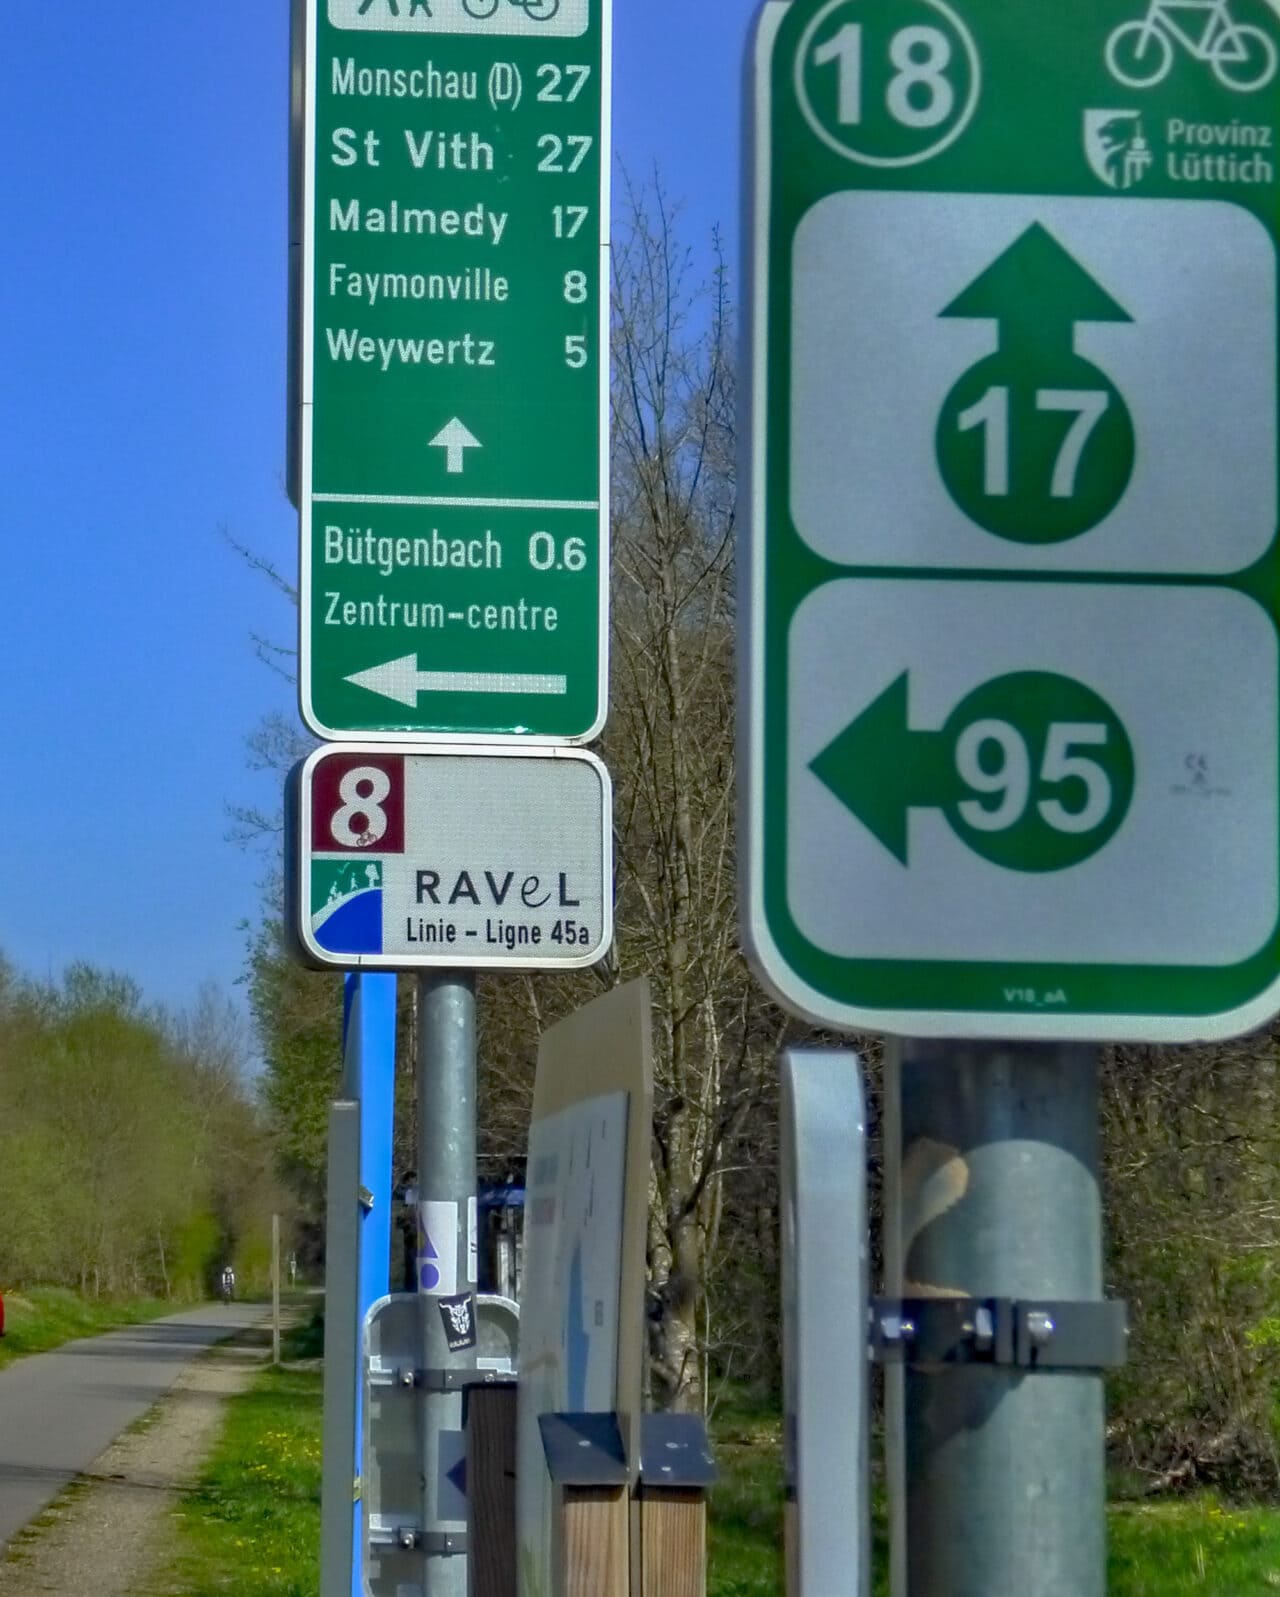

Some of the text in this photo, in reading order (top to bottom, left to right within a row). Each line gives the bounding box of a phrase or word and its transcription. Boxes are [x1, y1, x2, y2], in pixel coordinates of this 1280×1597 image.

[331, 57, 591, 111] Monschau (D) 27
[812, 23, 954, 129] 18
[331, 127, 592, 173] St Vith 27
[1166, 118, 1272, 147] Provinz
[1166, 151, 1273, 183] Lüttich
[329, 199, 589, 245] Malmedy 17
[329, 264, 588, 305] Faymonville 8
[326, 328, 587, 371] Weywertz 5
[956, 385, 1110, 499] 17
[324, 526, 587, 576] Bütgenbach 0.6
[324, 592, 558, 631] Zentrum-centre
[954, 718, 1113, 834] 95
[331, 766, 391, 848] 8
[406, 917, 456, 943] Linie
[486, 919, 542, 950] Ligne
[550, 920, 590, 945] 45a
